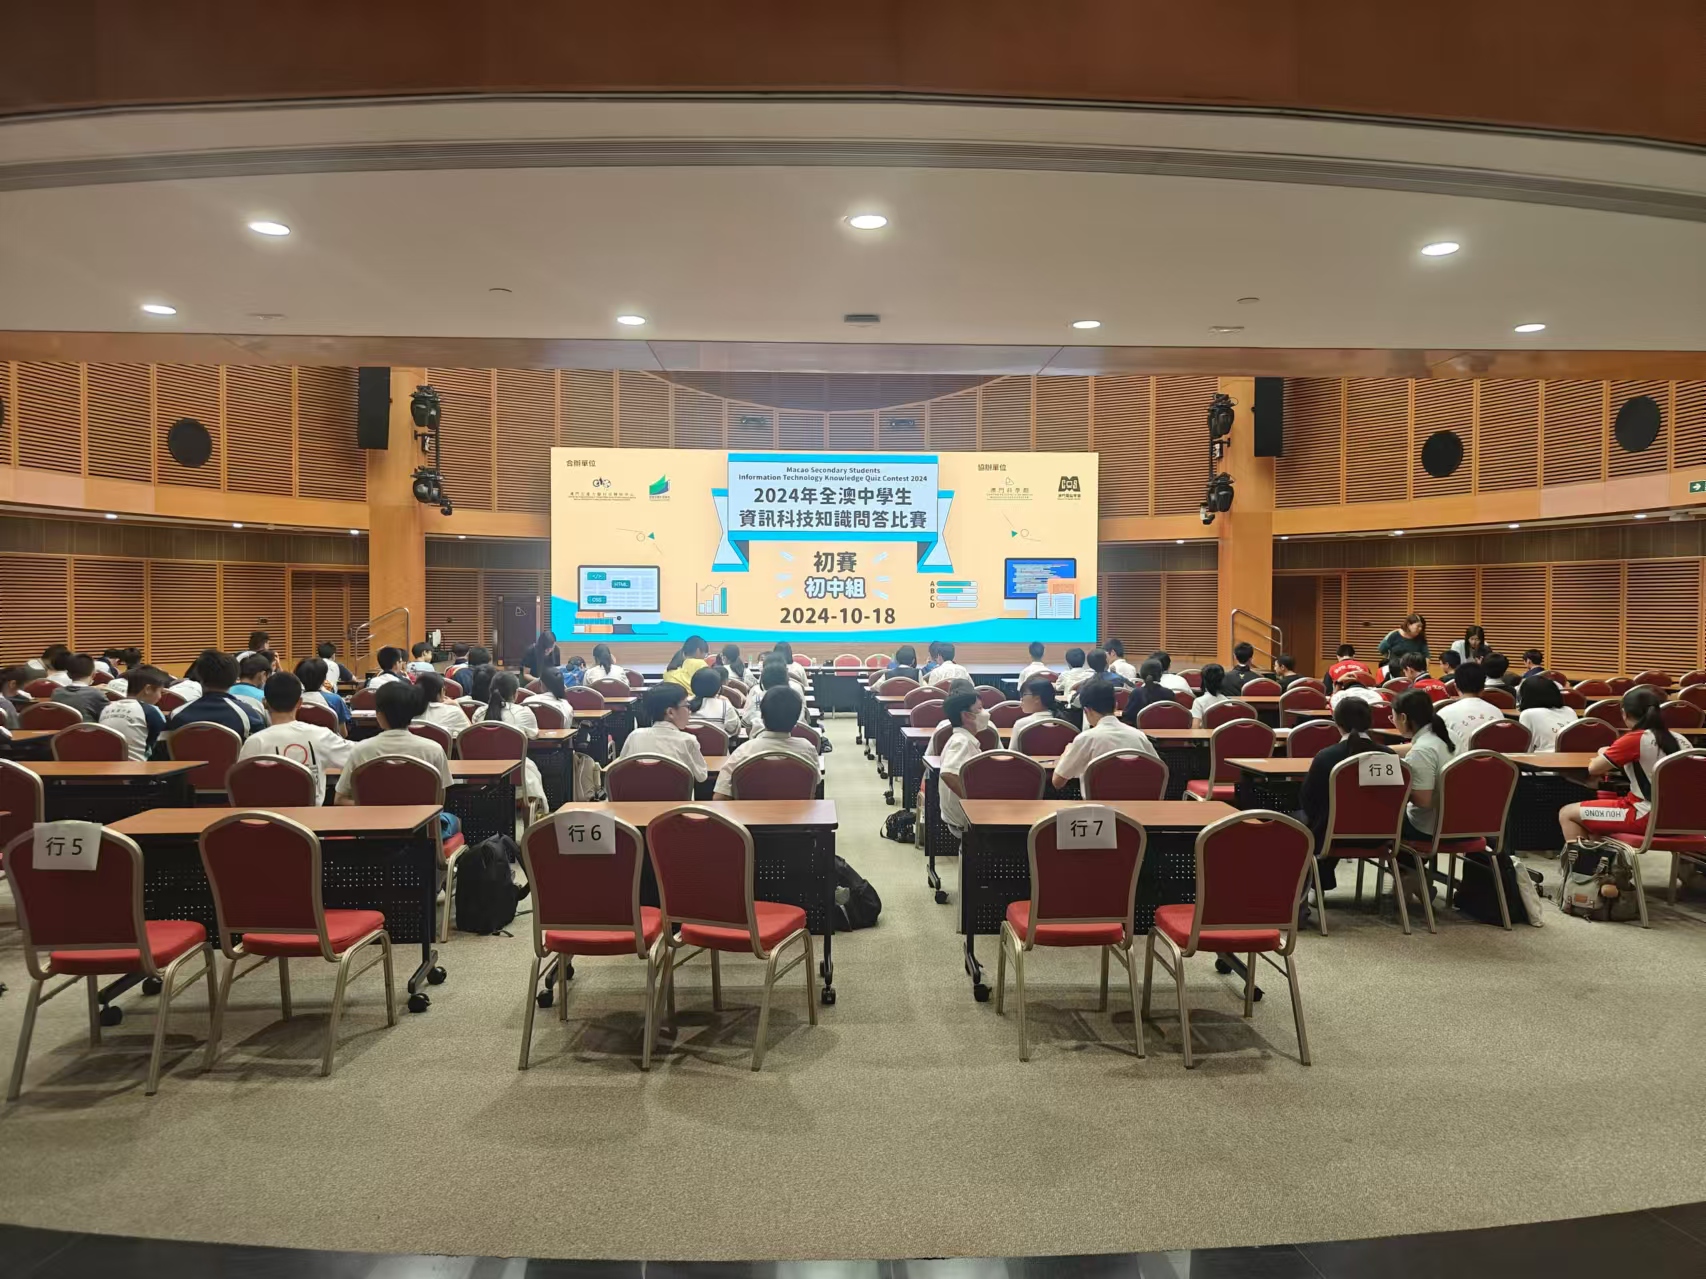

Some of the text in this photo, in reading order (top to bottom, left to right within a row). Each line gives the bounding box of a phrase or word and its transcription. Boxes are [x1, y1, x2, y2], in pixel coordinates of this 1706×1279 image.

[783, 474, 822, 482] Technology
[811, 467, 849, 475] Secondary
[754, 486, 912, 506] 2024年全澳中學生
[739, 510, 926, 528] 資訊科技知識問答比賽
[814, 551, 856, 572] 初賽
[804, 576, 866, 599] 初中組
[780, 608, 895, 624] 2024-10-18
[1369, 764, 1394, 776] 行 8
[1584, 809, 1604, 817] KONG
[568, 825, 601, 842] 行 6
[1070, 820, 1103, 837] 行 7
[45, 837, 82, 856] 行 5
